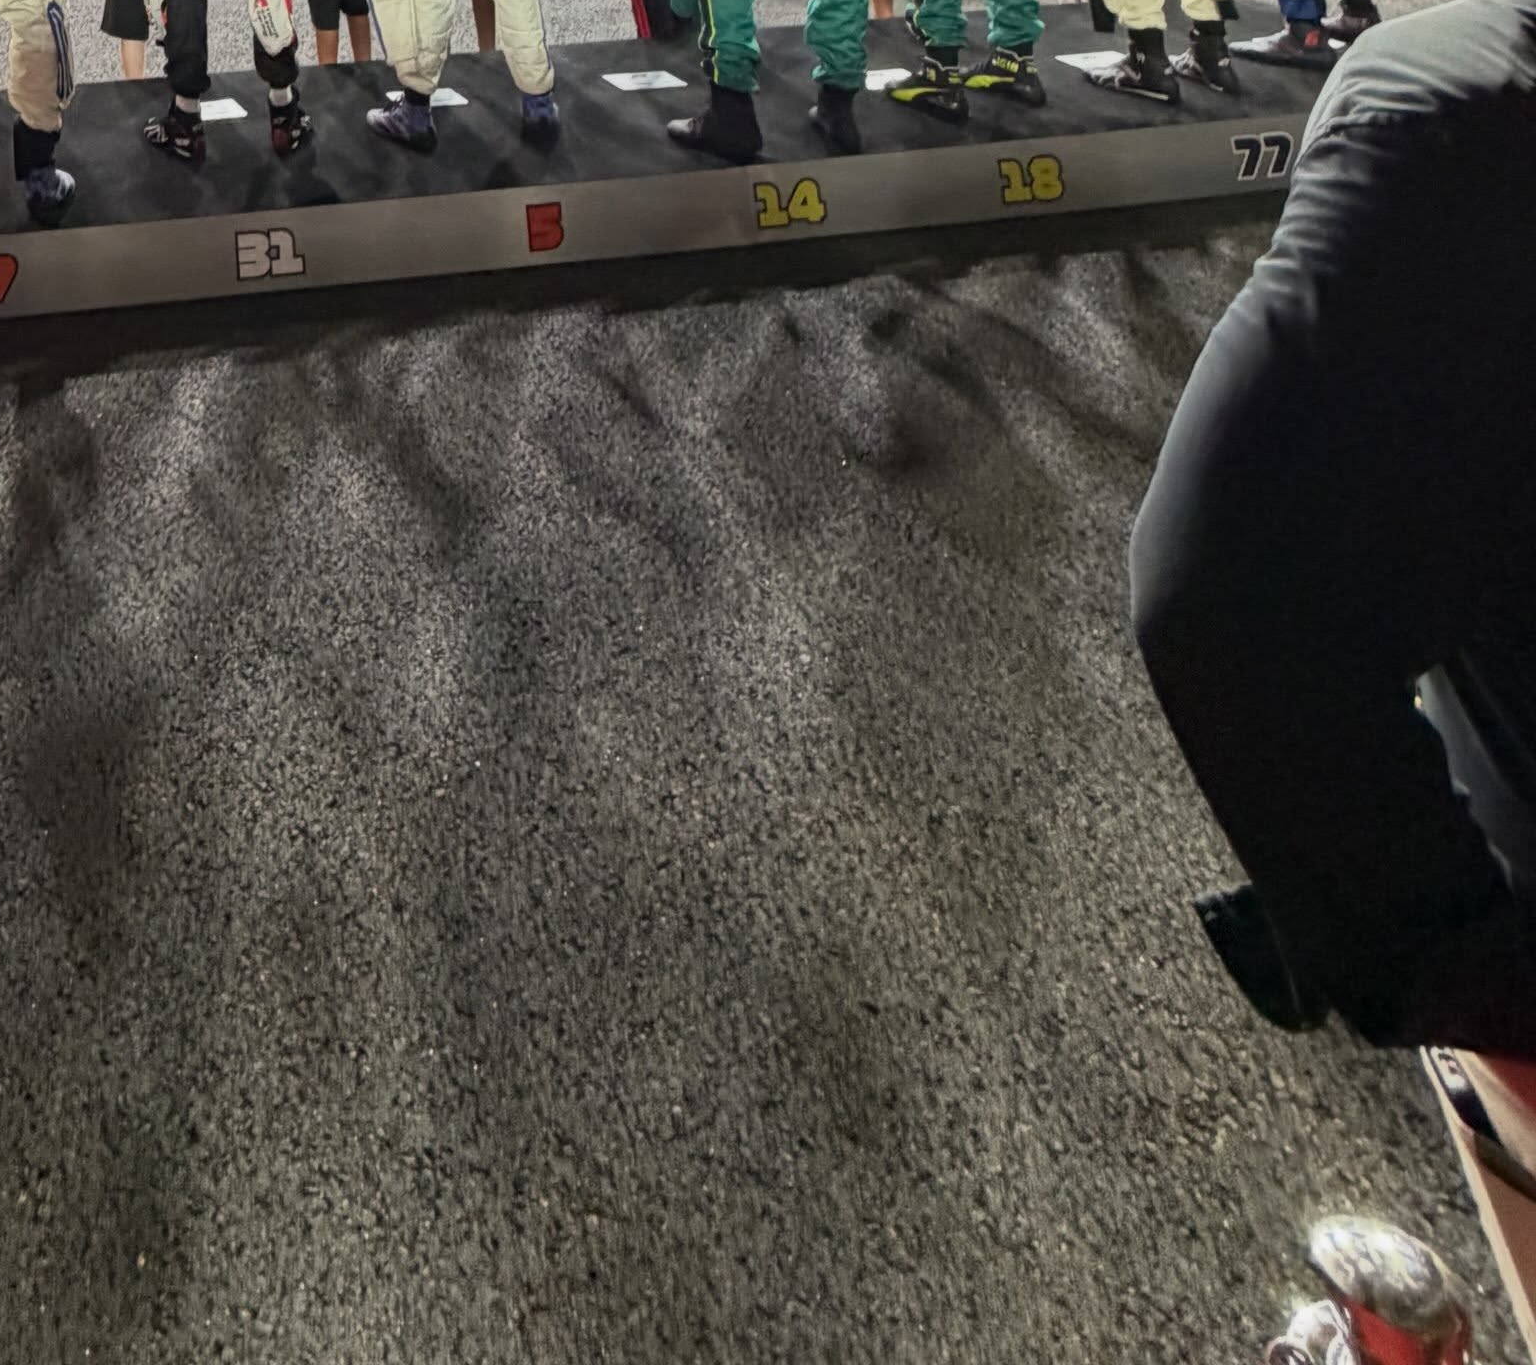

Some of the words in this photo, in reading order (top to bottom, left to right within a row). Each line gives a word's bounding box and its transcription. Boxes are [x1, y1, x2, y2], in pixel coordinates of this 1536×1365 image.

[997, 154, 1064, 205] 18
[1230, 131, 1295, 181] 77
[754, 177, 827, 229] 14
[235, 227, 305, 281] 31
